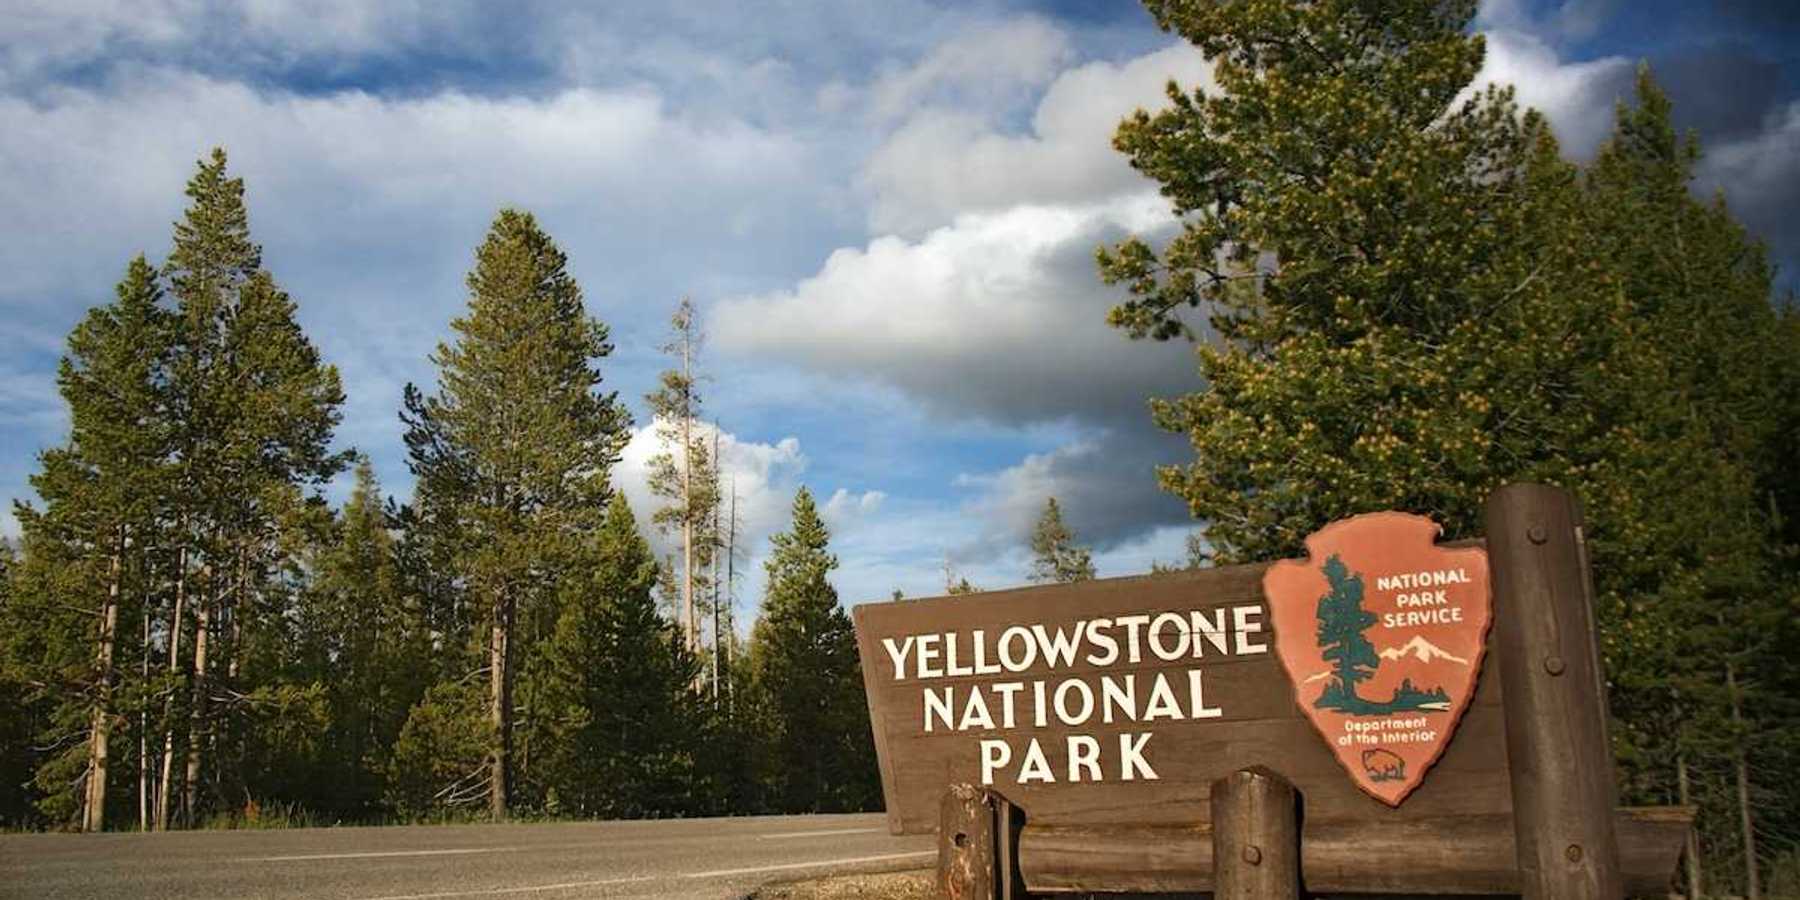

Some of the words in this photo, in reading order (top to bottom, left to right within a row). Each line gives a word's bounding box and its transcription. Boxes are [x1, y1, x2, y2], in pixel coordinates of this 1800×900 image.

[1378, 569, 1471, 591] NATIONAL
[1396, 590, 1448, 608] PARK
[1384, 608, 1463, 628] SERVICE
[883, 605, 1267, 680] YELLOWSTONE
[923, 670, 1222, 732] NATIONAL
[1345, 718, 1427, 734] Department
[1339, 732, 1354, 746] of
[1356, 731, 1378, 745] the
[1383, 730, 1437, 744] Interior
[980, 732, 1159, 785] PARK
